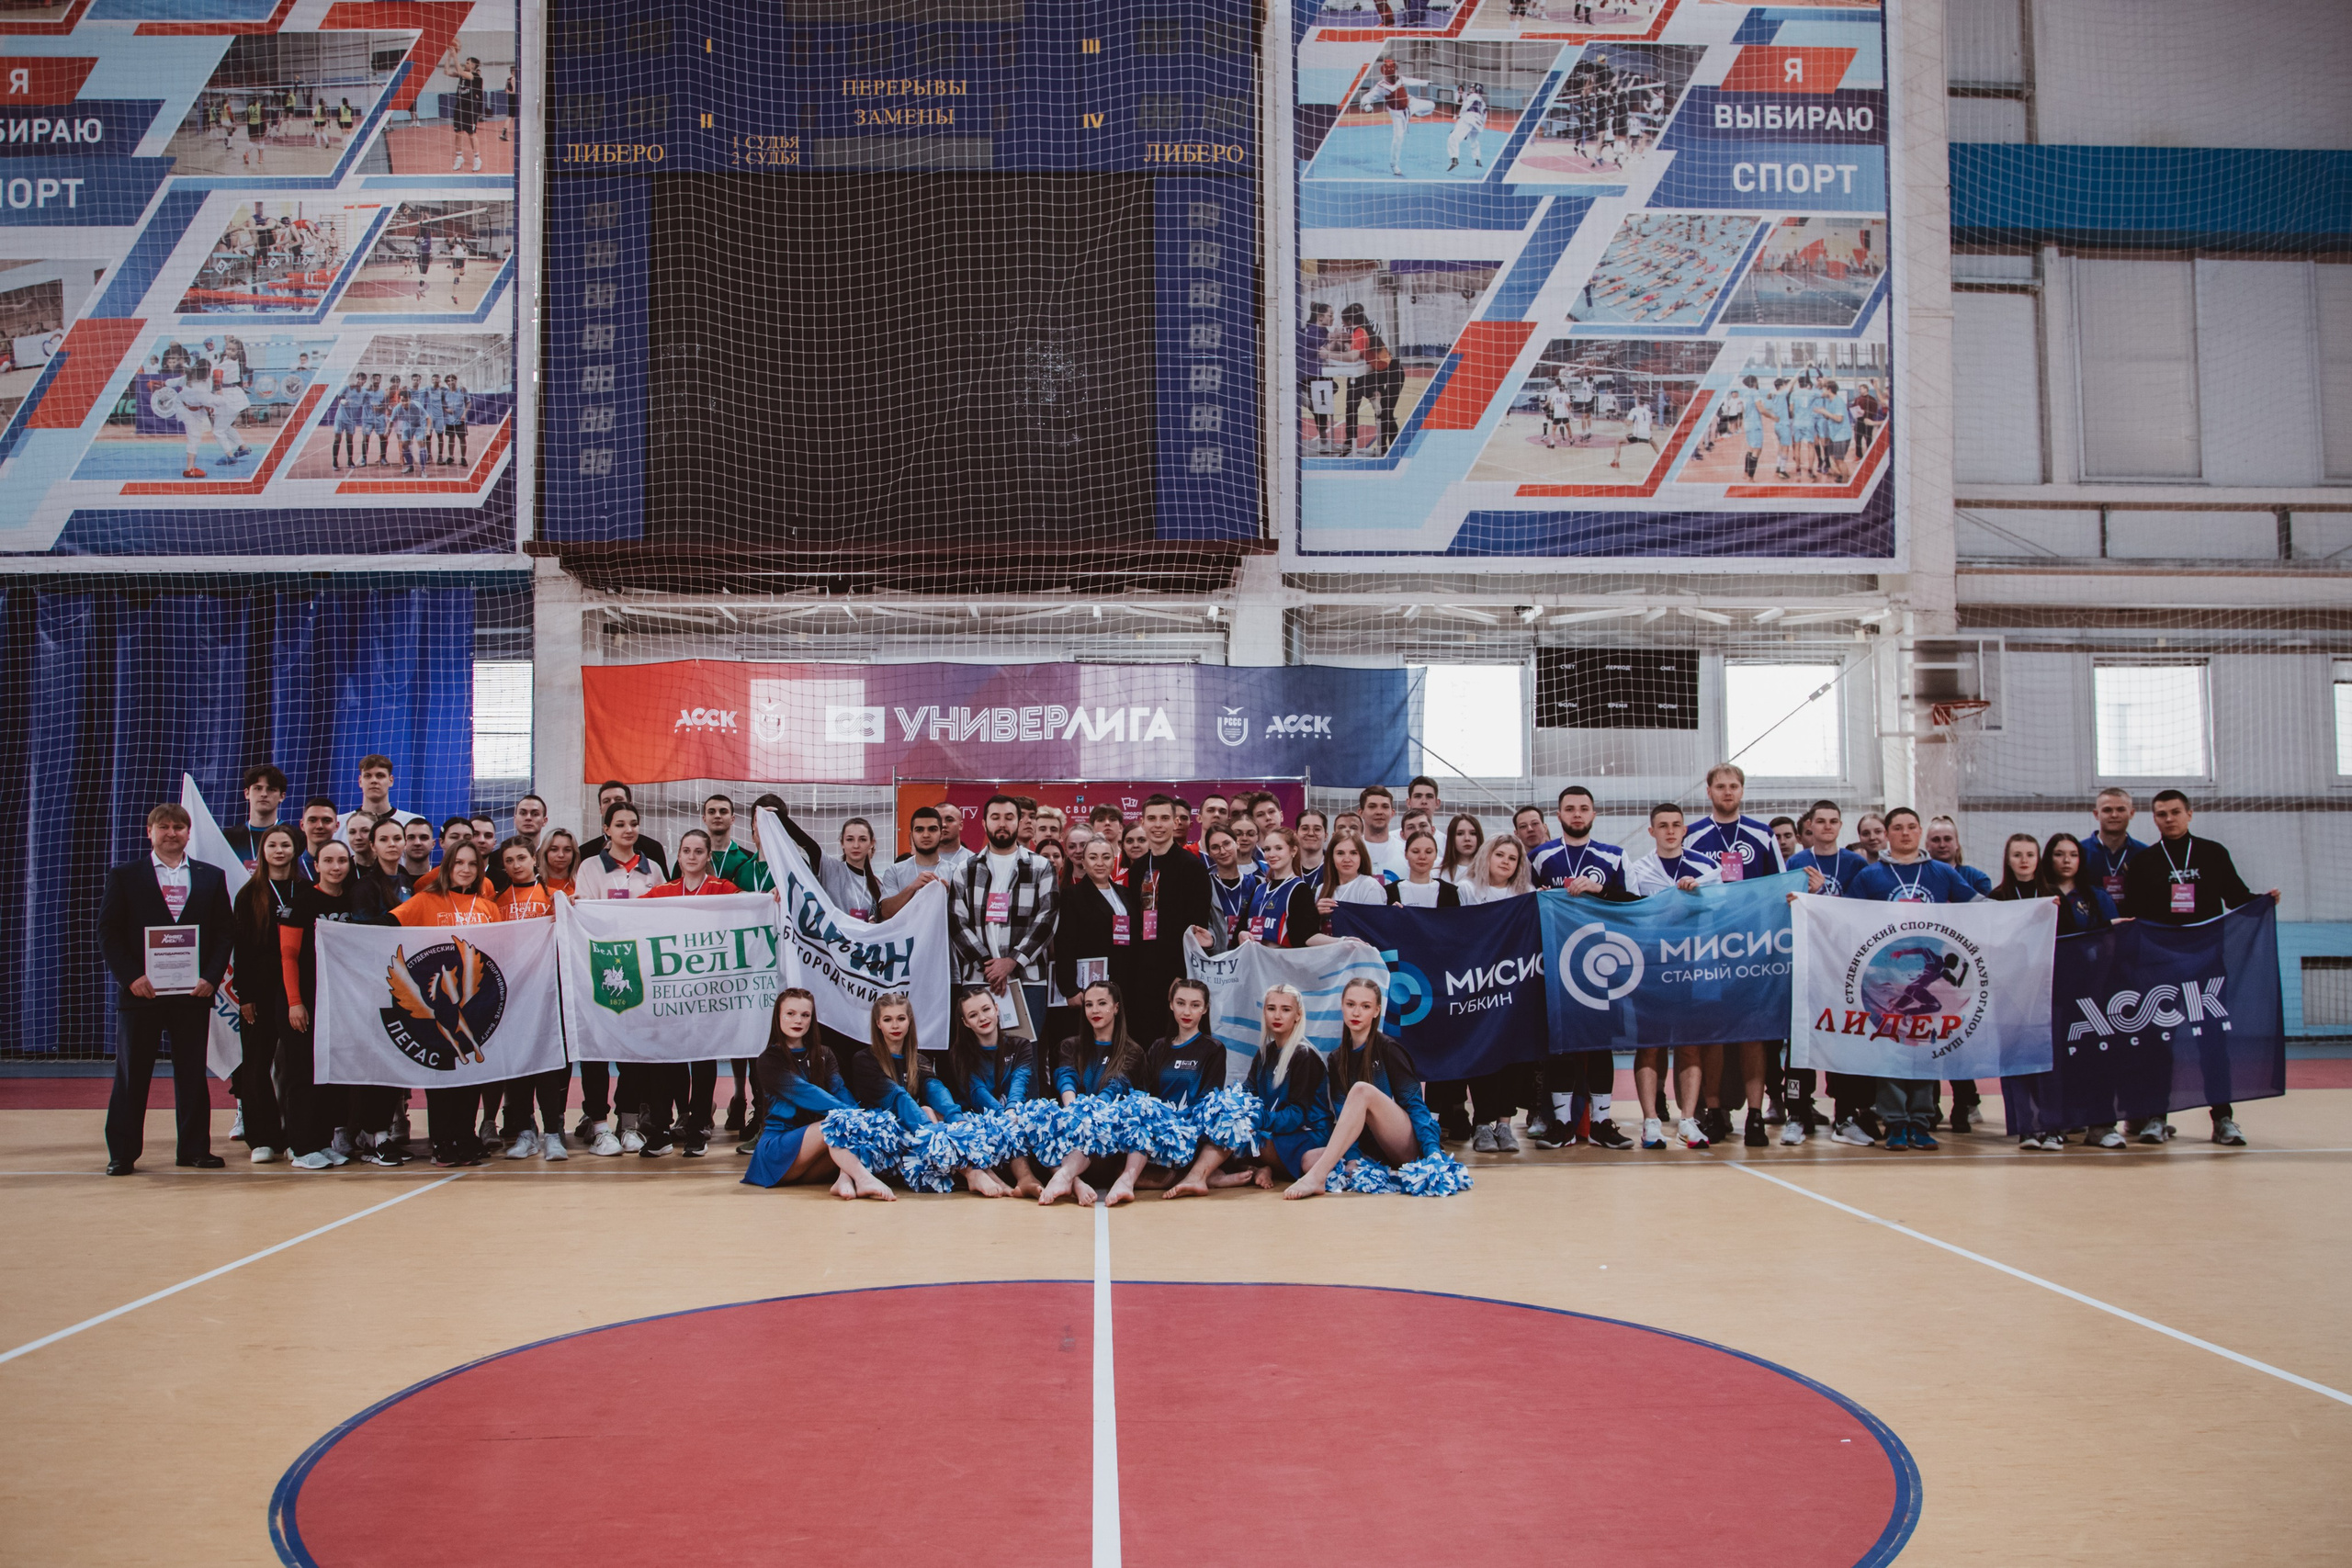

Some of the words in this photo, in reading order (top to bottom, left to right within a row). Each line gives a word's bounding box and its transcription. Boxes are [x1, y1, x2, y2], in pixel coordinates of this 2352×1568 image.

[9, 69, 29, 95] Я
[1783, 58, 1803, 83] Я
[842, 79, 967, 96] ПЕРЕРЫВЫ
[854, 108, 955, 126] ЗАМЕНЫ
[1083, 114, 1104, 129] IV
[1714, 105, 1873, 131] ВЫБИРАЮ
[563, 143, 664, 163] ЛИБЕРО
[745, 136, 800, 149] СУДЬЯ
[1144, 144, 1244, 164] ЛИБЕРО
[731, 152, 741, 164] 2
[745, 152, 800, 166] СУДЬЯ
[1733, 163, 1858, 194] СПОРТ
[0, 178, 85, 209] ОРТ
[1318, 389, 1327, 406] 1
[675, 707, 738, 728] АССК
[894, 705, 1176, 742] УНИВЕРЛИГА
[1266, 714, 1332, 733] АССК
[592, 942, 633, 957] БелГУ
[684, 930, 727, 948] НИУ
[1900, 921, 1979, 956] СПОРТИВНЫЙ
[407, 944, 456, 969] СТУДЕНЧЕСКИЙ
[646, 925, 780, 977] БелГУ
[783, 925, 878, 1003] БЕГОРОДСКИЙ
[1191, 952, 1238, 975] БГТУ
[1661, 964, 1731, 983] СТАРЫЙ
[1845, 924, 1897, 1004] СТУДЕНЧЕСКИЙ
[1973, 956, 1989, 987] КЛУБ
[651, 978, 748, 999] BELGOROD
[1214, 977, 1239, 986] Шухова
[652, 995, 754, 1017] UNIVERSITY
[1449, 992, 1512, 1015] ГУБКИН
[1964, 990, 1988, 1038] ОГАПОУ
[2067, 976, 2229, 1041] АССК
[1815, 1008, 1962, 1043] ЛИДЕР
[387, 1020, 440, 1066] ПЕГАС
[2068, 1021, 2233, 1055] РОССИИ
